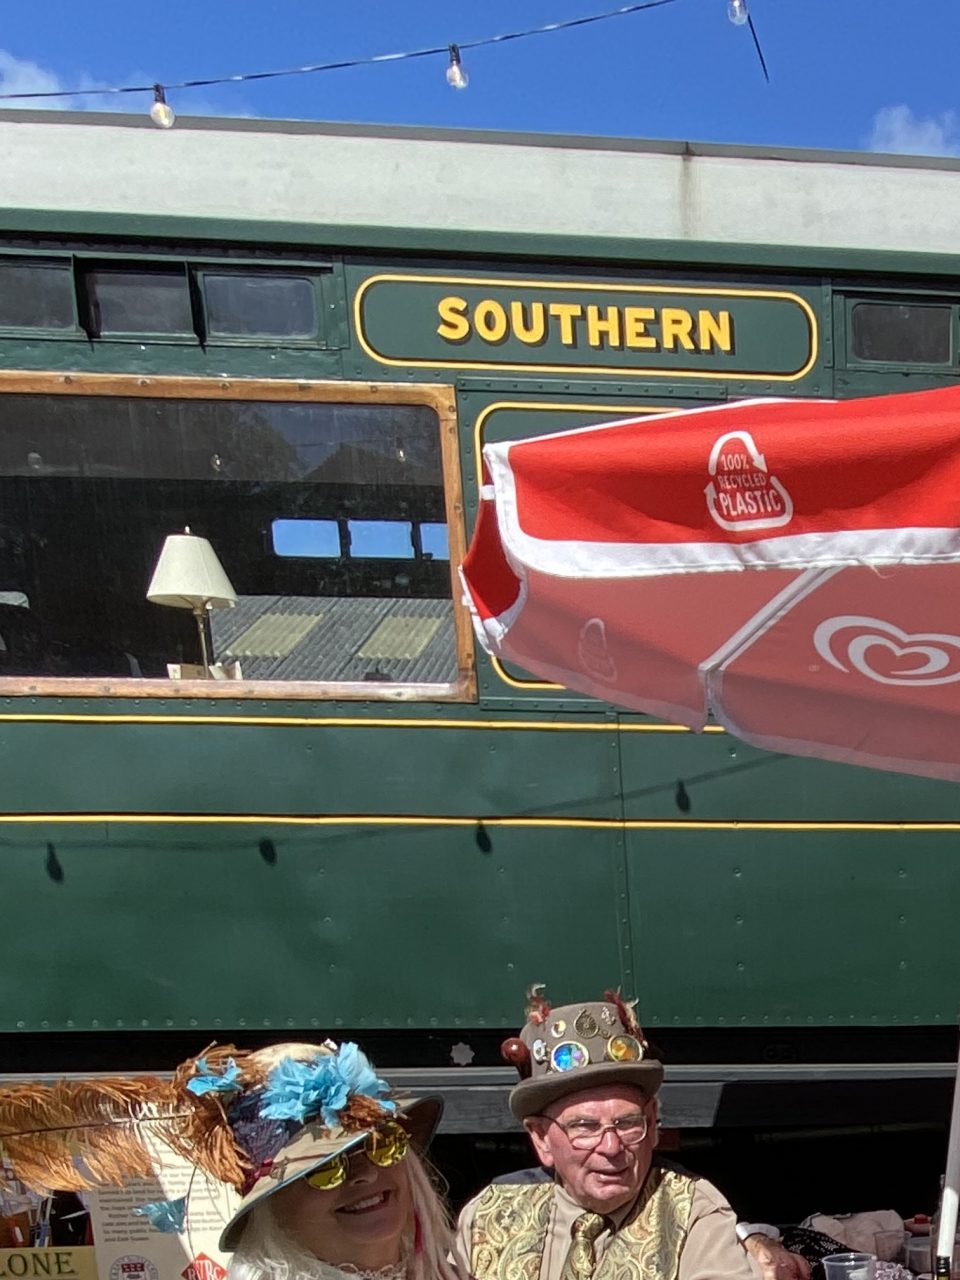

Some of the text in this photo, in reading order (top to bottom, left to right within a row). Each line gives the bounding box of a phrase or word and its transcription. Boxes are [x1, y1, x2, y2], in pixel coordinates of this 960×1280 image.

[437, 296, 734, 354] SOUTHERN
[720, 453, 750, 472] 100%
[717, 472, 767, 490] RECYCLED
[718, 489, 782, 517] PLASTIC
